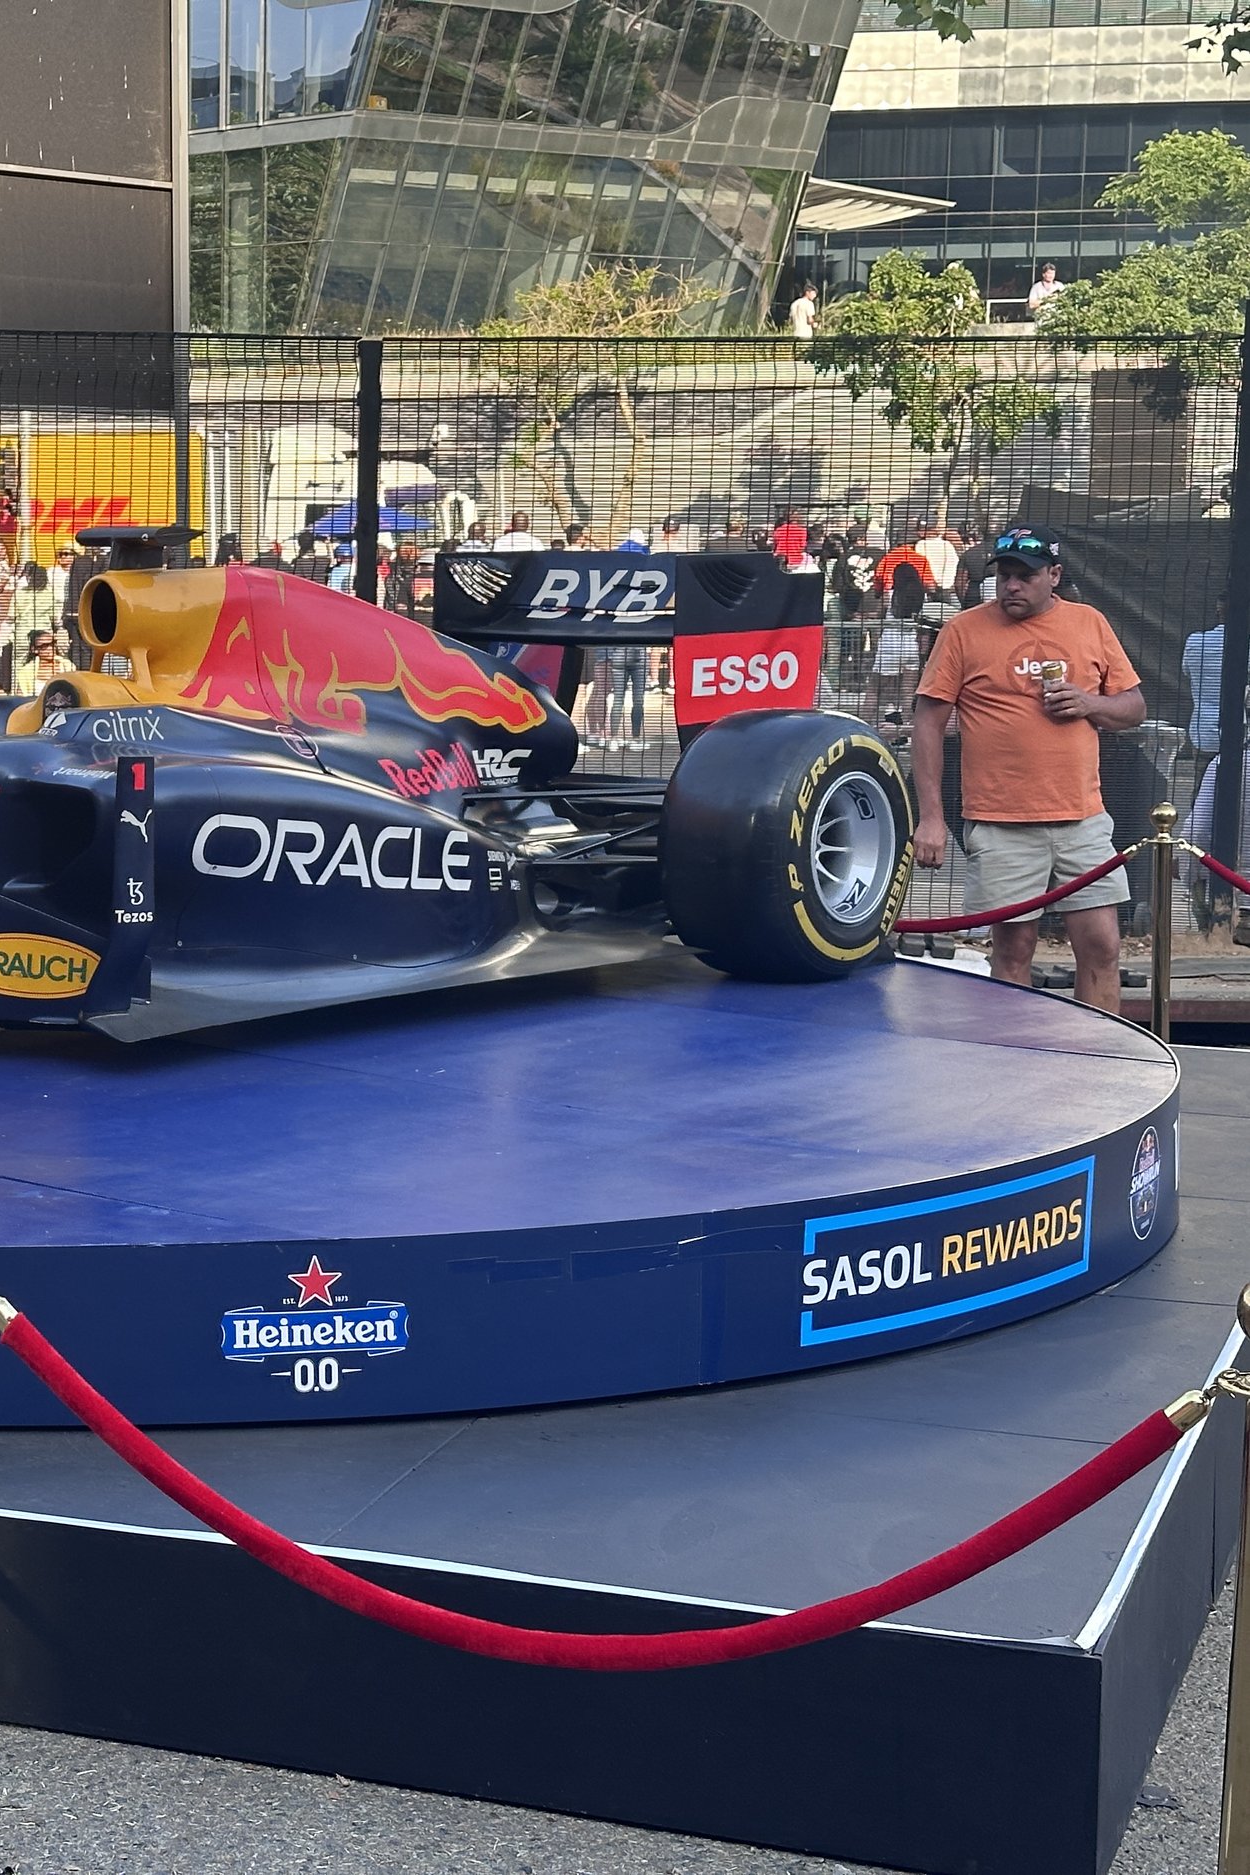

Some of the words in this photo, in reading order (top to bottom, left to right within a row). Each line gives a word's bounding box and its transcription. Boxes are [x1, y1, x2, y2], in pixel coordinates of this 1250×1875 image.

[526, 568, 677, 625] BYB
[691, 651, 800, 699] ESSO
[1014, 657, 1068, 681] Je
[92, 709, 165, 743] citrix
[130, 762, 147, 791] 1
[791, 737, 847, 847] ZERO
[191, 813, 473, 892] ORACLE
[880, 841, 915, 938] PIRELLI
[114, 909, 154, 924] Tezos
[802, 1242, 932, 1305] SASOL
[941, 1197, 1082, 1278] REWARDS
[233, 1314, 398, 1349] Heineken
[293, 1356, 340, 1393] 0.0
